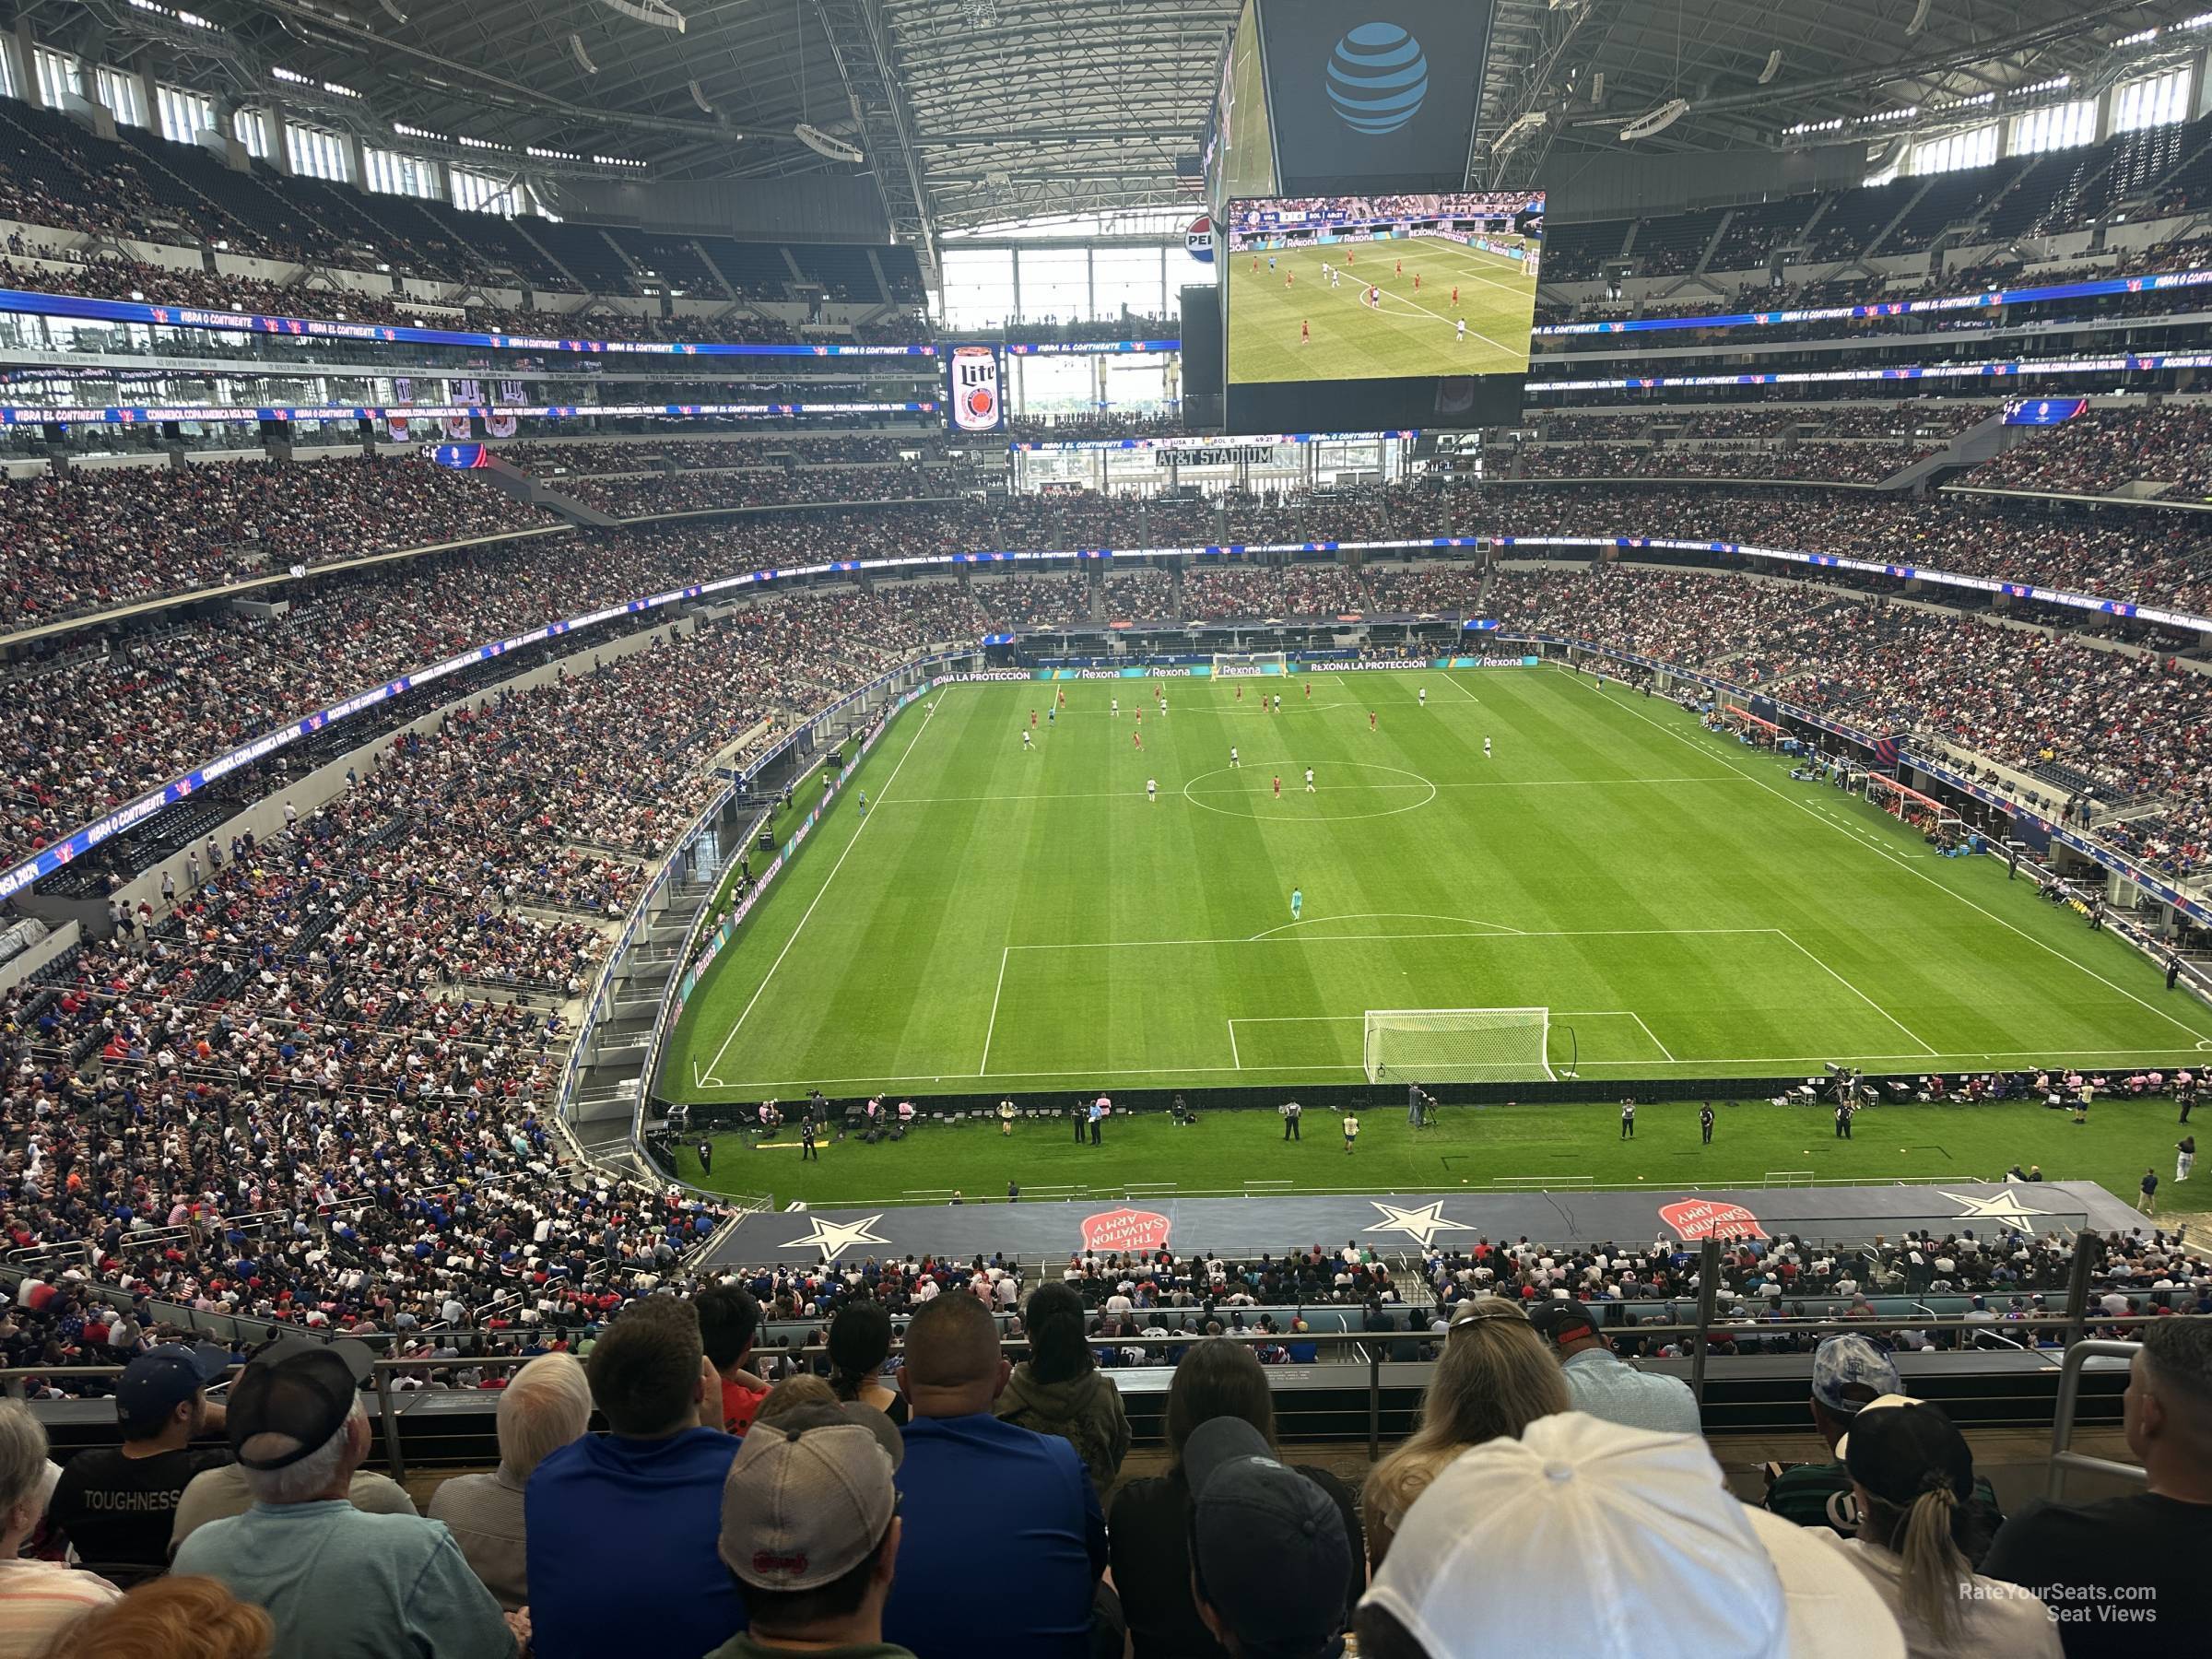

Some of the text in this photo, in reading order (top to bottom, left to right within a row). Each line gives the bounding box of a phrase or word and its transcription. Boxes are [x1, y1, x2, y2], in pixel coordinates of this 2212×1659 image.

[1288, 238, 1317, 248] Rexona
[1344, 234, 1373, 243] Rexona
[181, 312, 253, 327] VIBRA O CONTINENTE
[309, 323, 376, 337] VIBRA EL CONTINENTE
[1554, 324, 1599, 334] CONTINENTE
[839, 347, 858, 355] VIBRA
[1038, 344, 1059, 352] VIBRA
[959, 364, 994, 387] Lite
[16, 410, 105, 421] VIBRA EL CONTINENTE
[700, 406, 769, 414] VIBRA EL CONTINENTE
[1076, 441, 1123, 449] CONTINENTE
[1157, 446, 1272, 466] AT&T STADIUM
[1312, 659, 1426, 671] REXONA LA PROTECCIÓN
[1484, 657, 1523, 667] Rexona
[957, 674, 969, 682] LA
[970, 671, 1030, 682] PROTECCIÓN
[1082, 669, 1120, 679] Rexona
[1152, 667, 1191, 677] Rexona
[1223, 665, 1261, 676] Rexona
[88, 792, 166, 844] VIBRA O CONTINENTE
[795, 824, 809, 846] Rexona
[0, 863, 39, 895] USA 2024
[734, 899, 753, 925] REXONA
[696, 944, 716, 982] Rexona
[1677, 1204, 1712, 1225] ARMY
[1682, 1208, 1747, 1236] SALVATION
[1094, 1214, 1137, 1234] ARMY
[1714, 1221, 1748, 1238] THE
[1091, 1218, 1164, 1248] SALVATION
[1121, 1232, 1154, 1248] THE
[85, 1489, 181, 1512] TOUGHNESS
